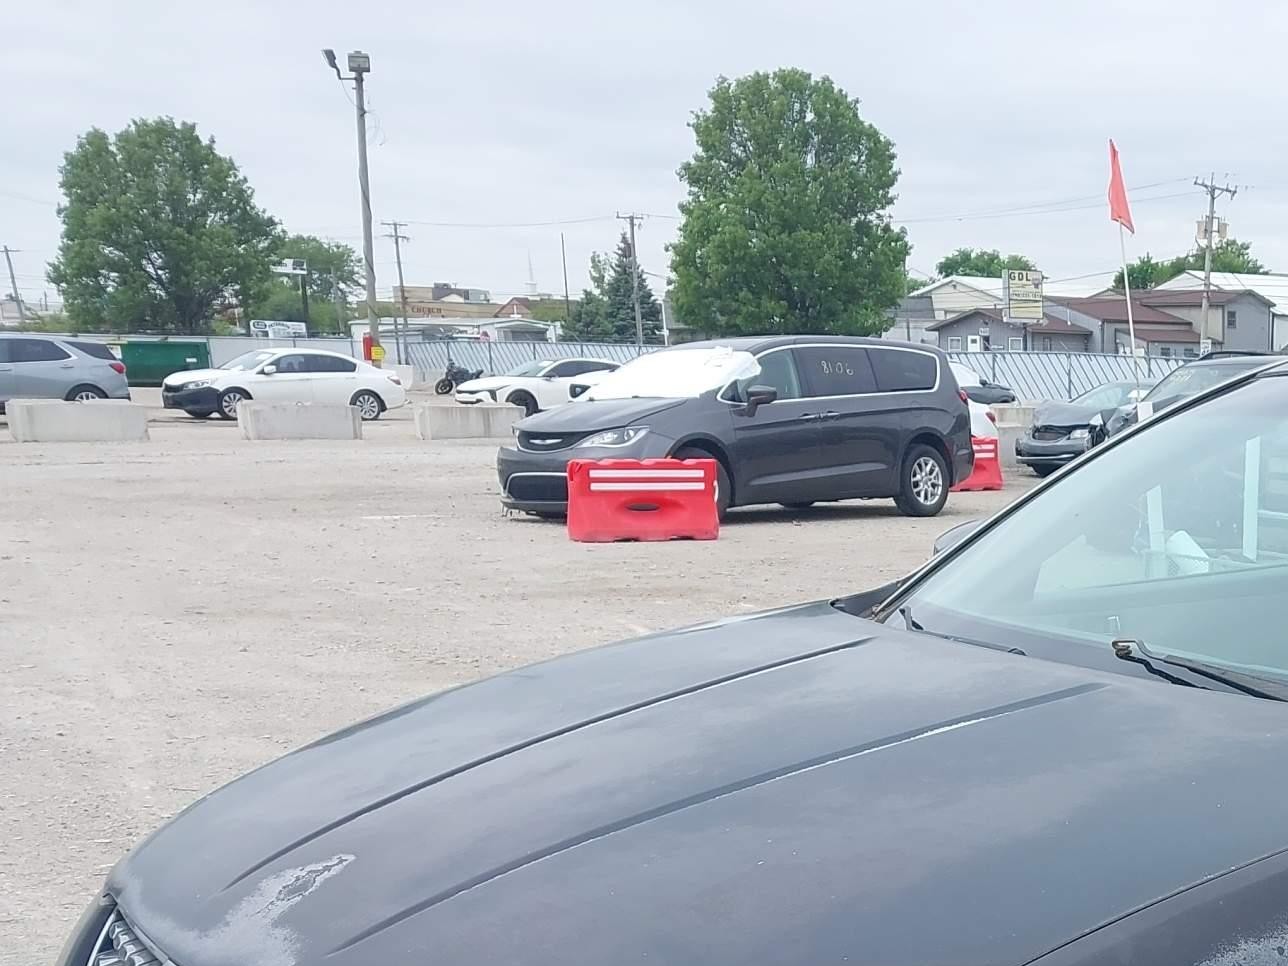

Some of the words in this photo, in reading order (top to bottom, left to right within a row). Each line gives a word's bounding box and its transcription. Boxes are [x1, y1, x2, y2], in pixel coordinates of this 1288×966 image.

[1009, 271, 1032, 282] GDL
[411, 305, 442, 315] CHURCH
[821, 360, 854, 376] 8106
